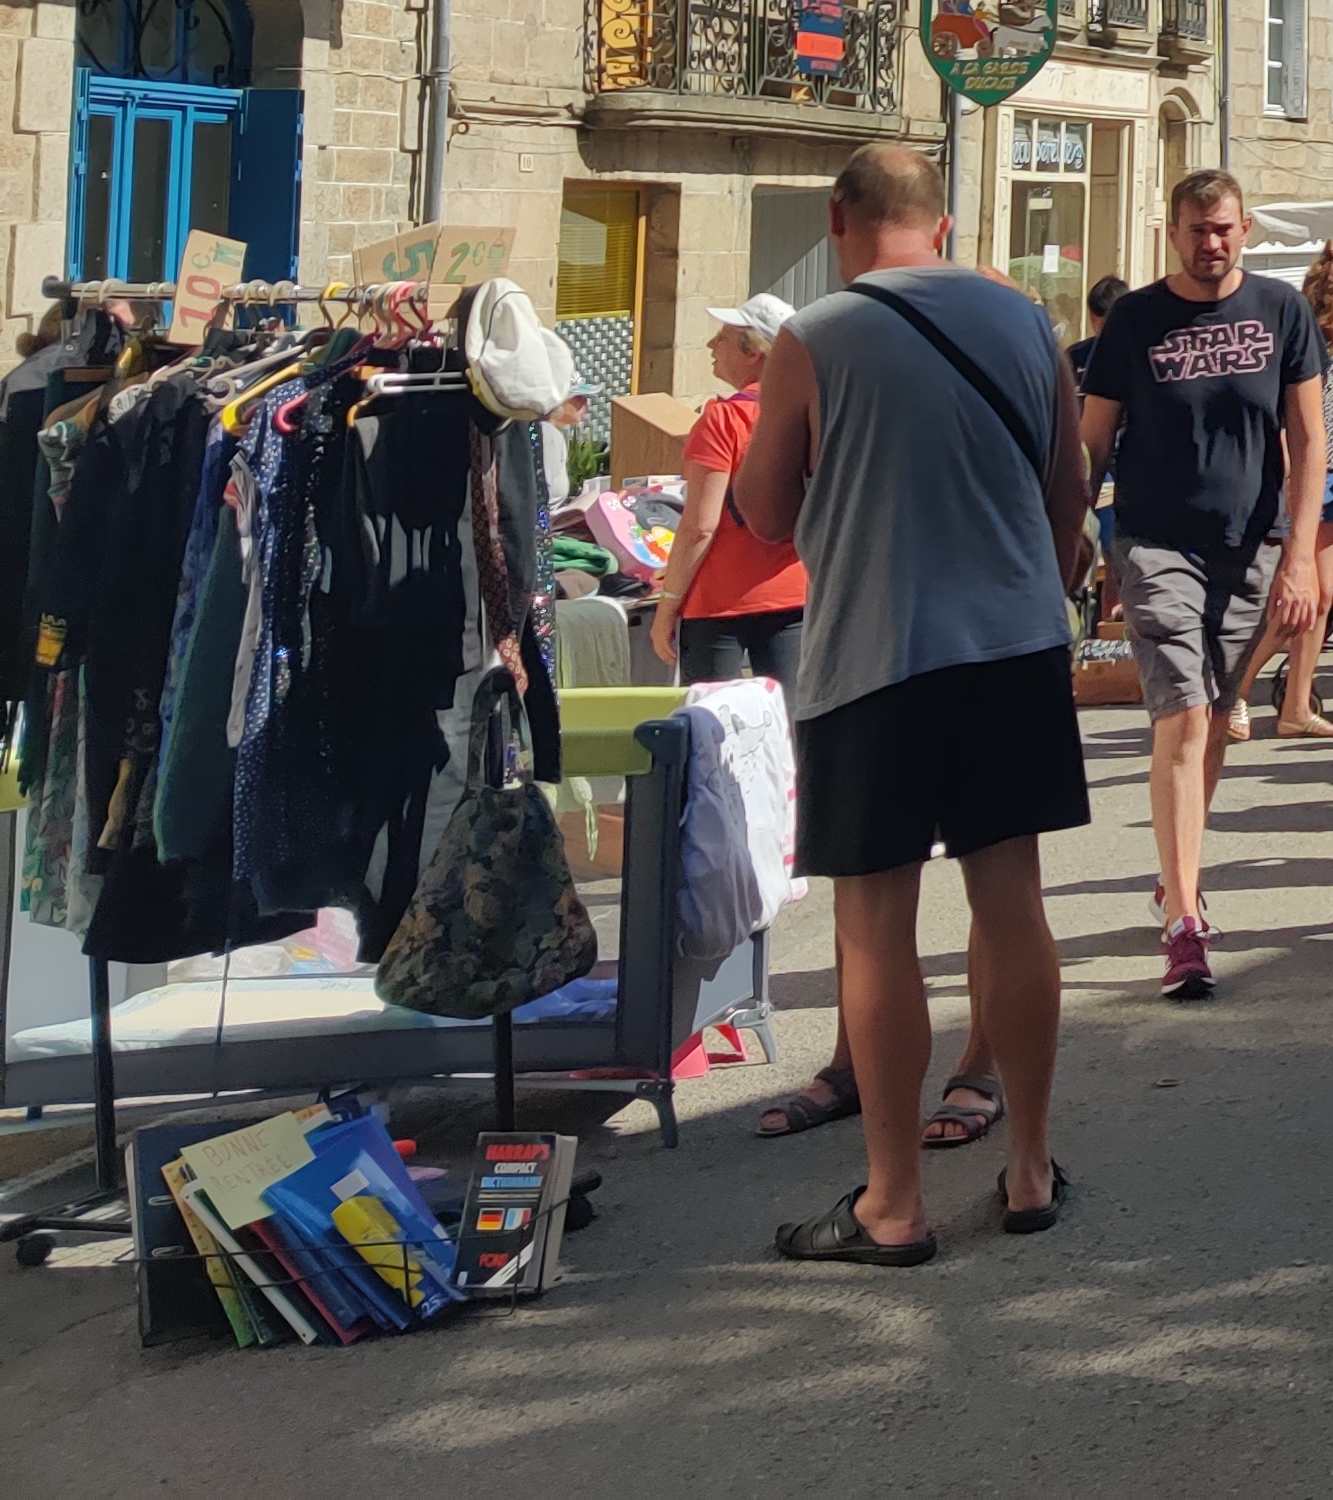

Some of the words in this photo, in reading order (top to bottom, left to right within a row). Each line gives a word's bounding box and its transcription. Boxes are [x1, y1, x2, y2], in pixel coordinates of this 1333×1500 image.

[1149, 319, 1274, 356] STAR
[1149, 347, 1272, 383] WARS
[202, 1127, 270, 1168] BONNE
[493, 1161, 538, 1174] COMPACT
